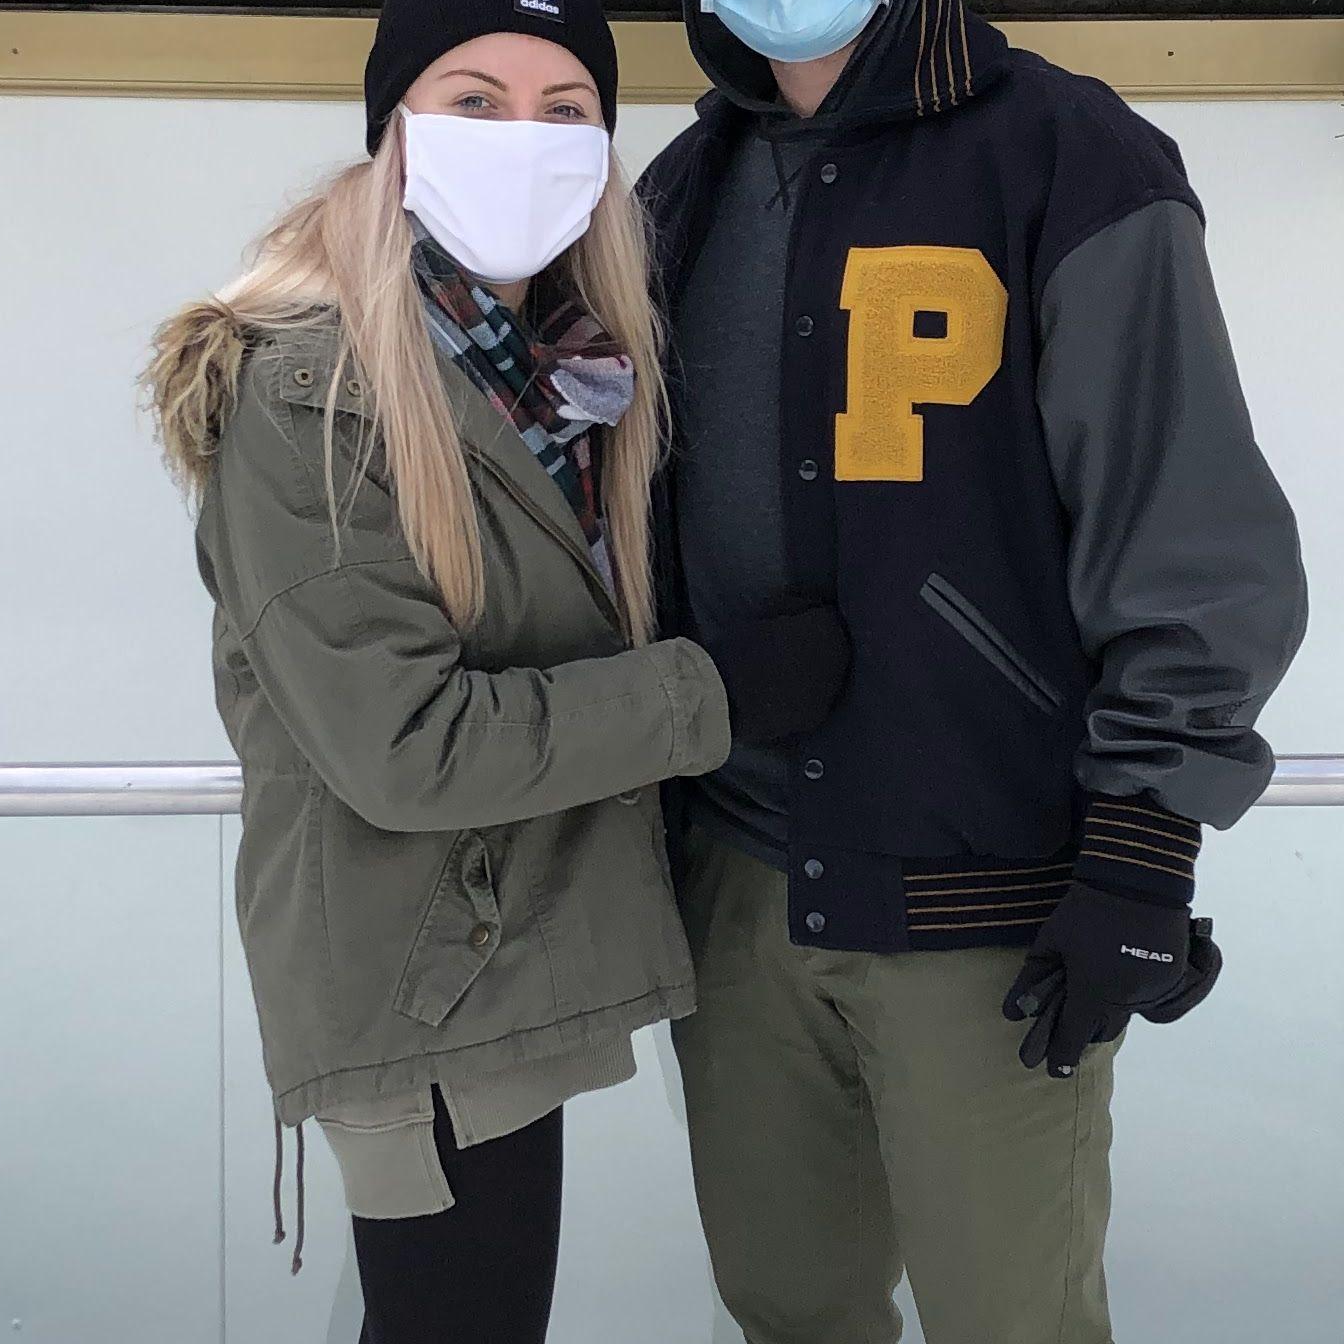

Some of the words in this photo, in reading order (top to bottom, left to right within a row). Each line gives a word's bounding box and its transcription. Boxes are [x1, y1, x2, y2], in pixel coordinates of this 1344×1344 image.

[520, 0, 560, 14] adidas
[835, 245, 1009, 482] P
[1120, 944, 1174, 963] HEAD
